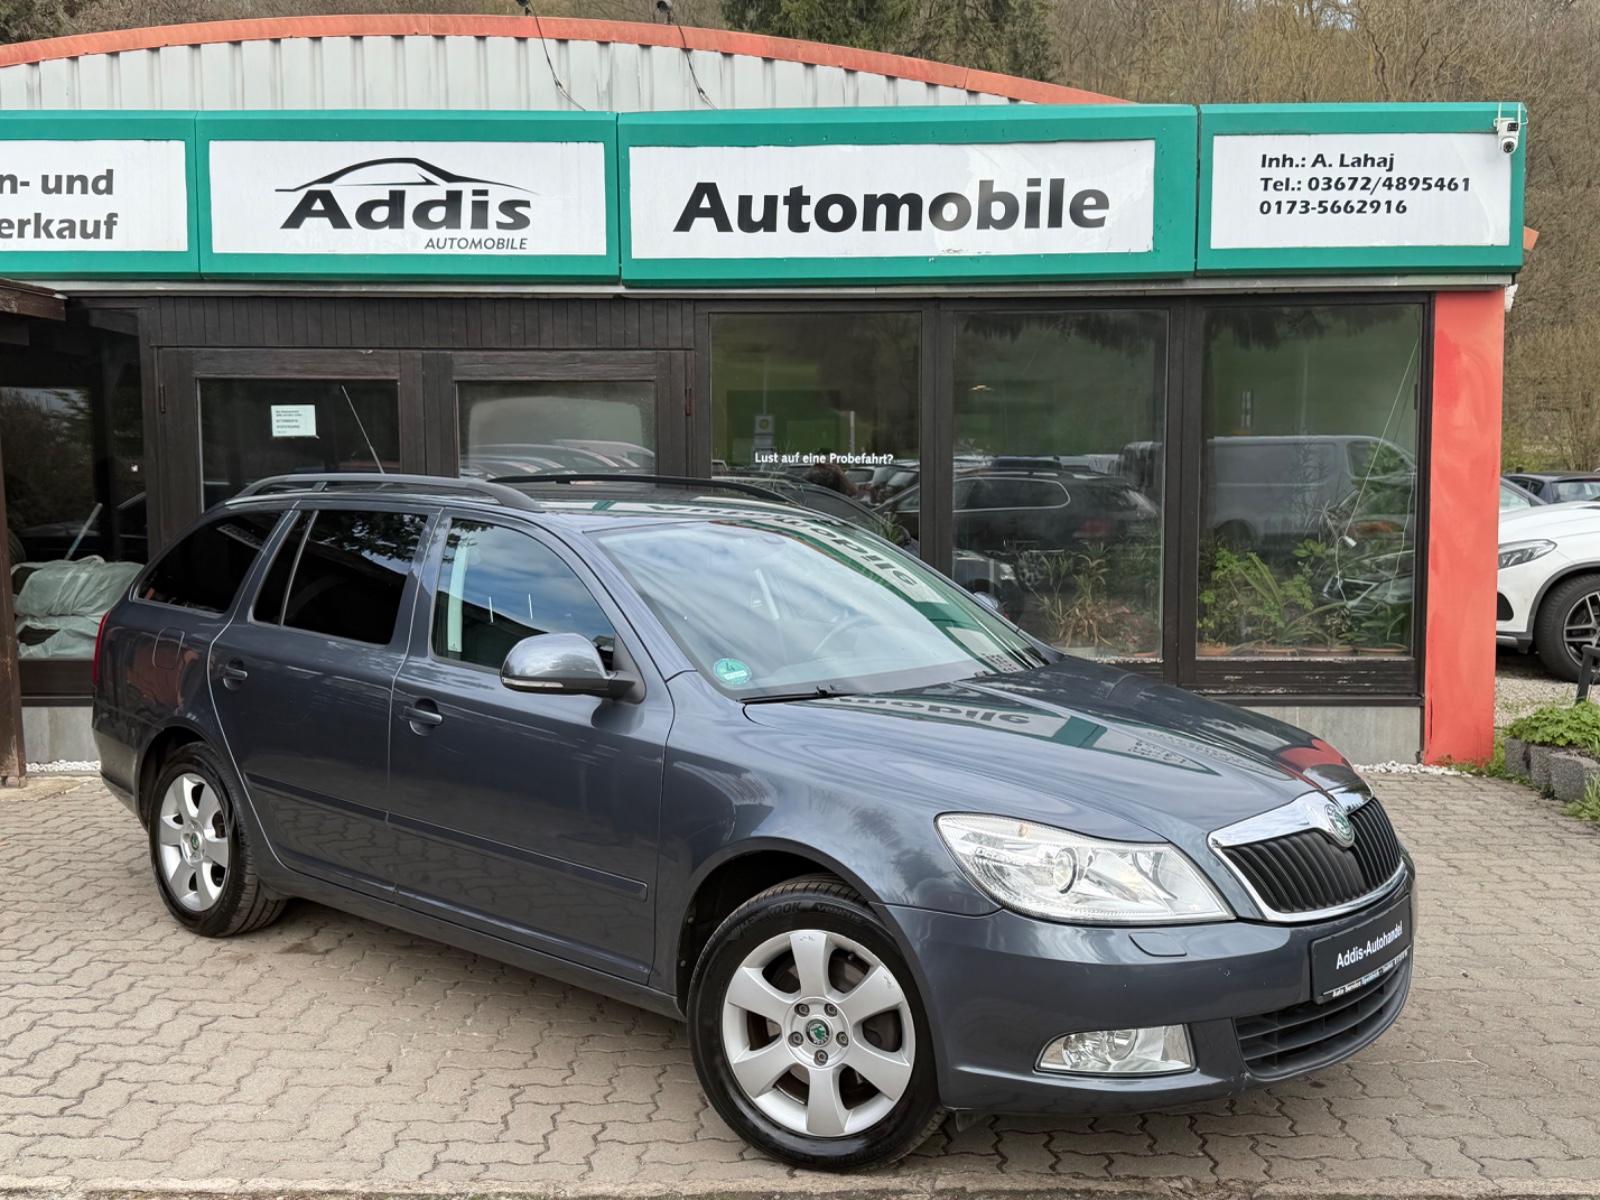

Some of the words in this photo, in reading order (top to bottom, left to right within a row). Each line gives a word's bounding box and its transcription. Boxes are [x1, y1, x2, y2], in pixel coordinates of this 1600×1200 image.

[1260, 153, 1306, 168] Inh.:
[1310, 153, 1333, 168] A.
[1337, 153, 1395, 173] Lahaj
[41, 168, 114, 196] und
[1260, 176, 1302, 192] Tel.:
[1307, 176, 1470, 195] 03672/4895461
[280, 188, 532, 231] Addis
[673, 177, 1110, 234] Automobile
[1259, 199, 1408, 215] 0173-5662916
[424, 237, 529, 250] AUTOMOBILE
[754, 452, 779, 464] Lust
[781, 452, 800, 464] auf
[802, 453, 827, 464] eine
[829, 452, 894, 465] Probefahrt?
[1335, 919, 1403, 970] Addis-Autohandel
